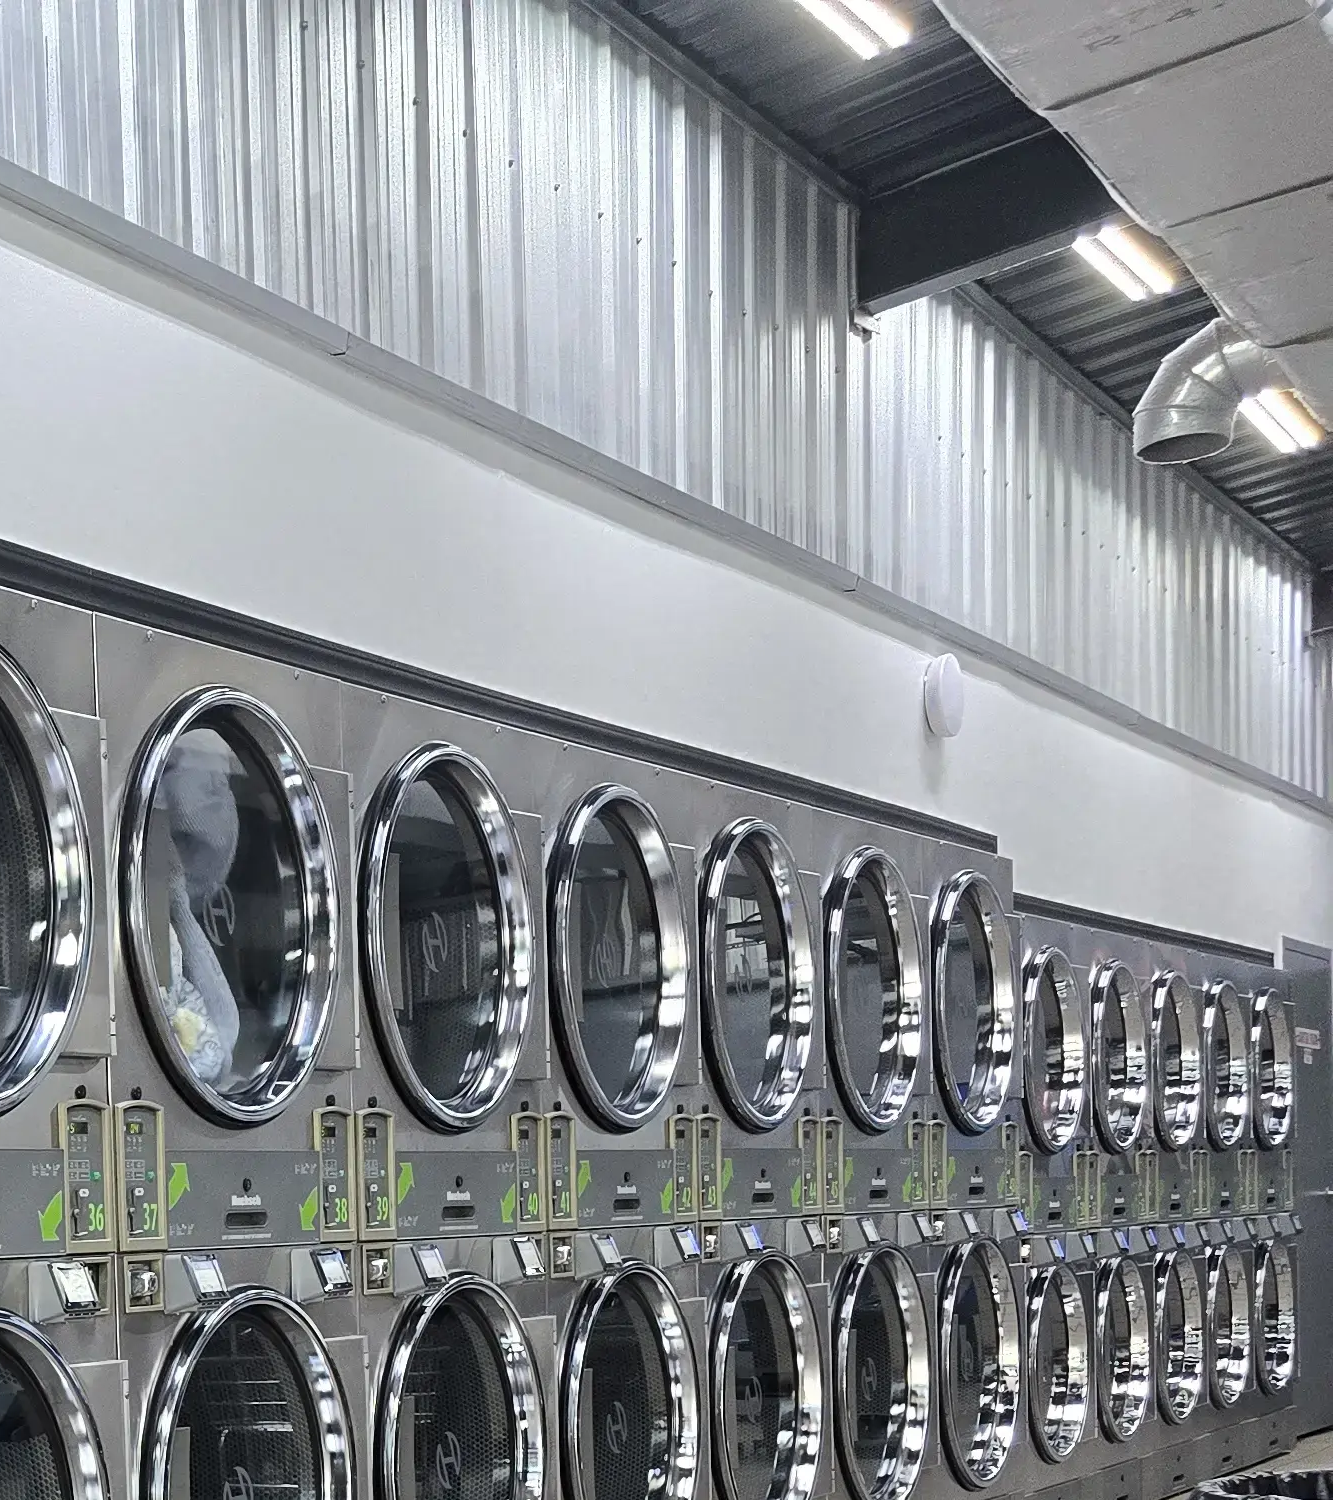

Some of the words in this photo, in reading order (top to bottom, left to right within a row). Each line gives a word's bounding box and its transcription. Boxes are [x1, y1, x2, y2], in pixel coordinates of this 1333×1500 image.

[88, 1203, 104, 1231] 36
[142, 1202, 158, 1231] 37
[335, 1198, 347, 1222] 38
[376, 1196, 389, 1220] 39
